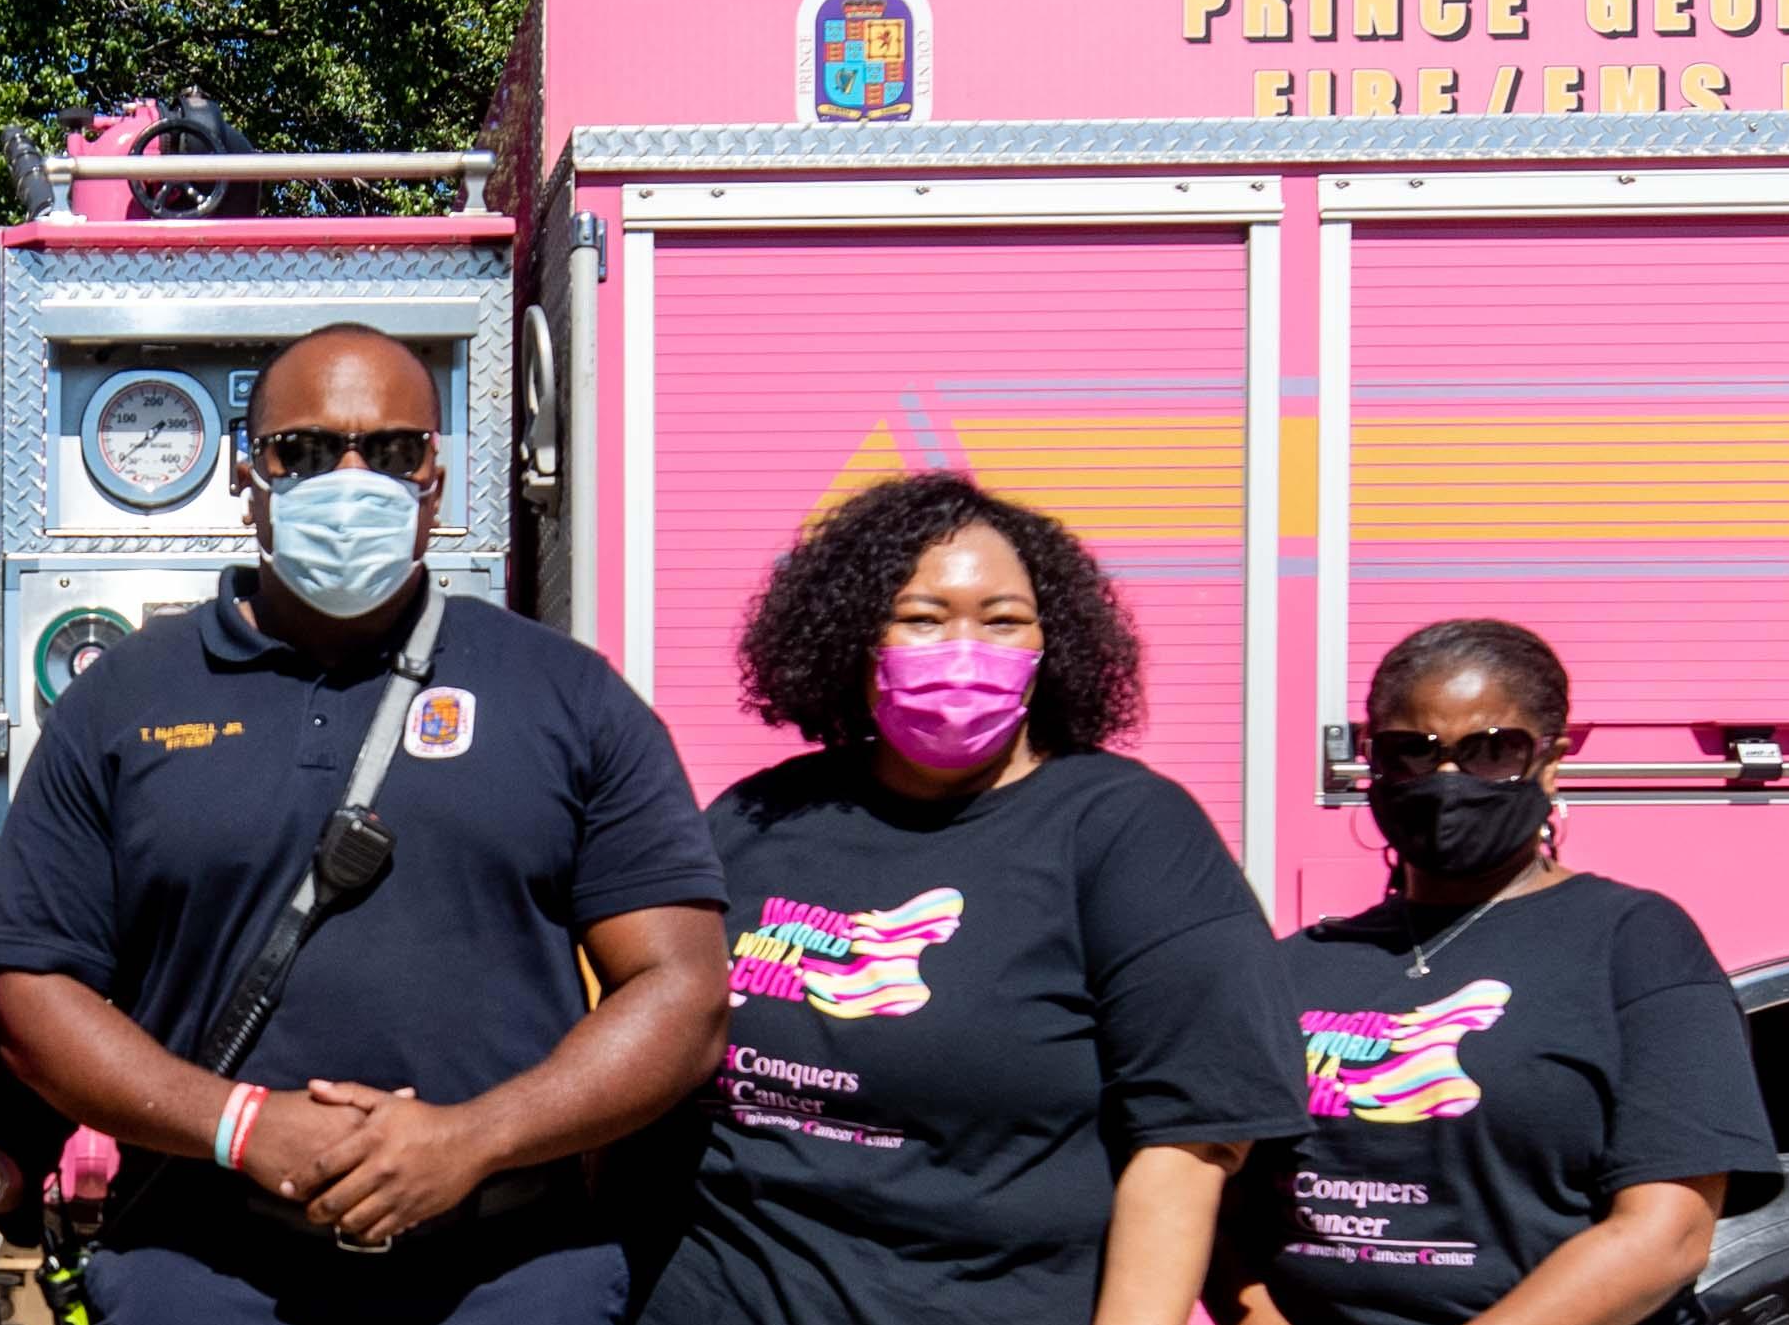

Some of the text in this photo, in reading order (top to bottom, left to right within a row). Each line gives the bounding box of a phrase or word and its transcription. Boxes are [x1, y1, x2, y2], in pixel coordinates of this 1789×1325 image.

[1254, 62, 1729, 117] FIRE/EMS
[142, 395, 164, 407] 200
[116, 412, 137, 424] 100
[167, 418, 188, 429] 300
[733, 931, 805, 966] WITH A
[773, 920, 852, 960] WORLD
[727, 956, 806, 1003] CURE
[1359, 1244, 1418, 1265] Cancer
[1417, 1247, 1476, 1267] Center
